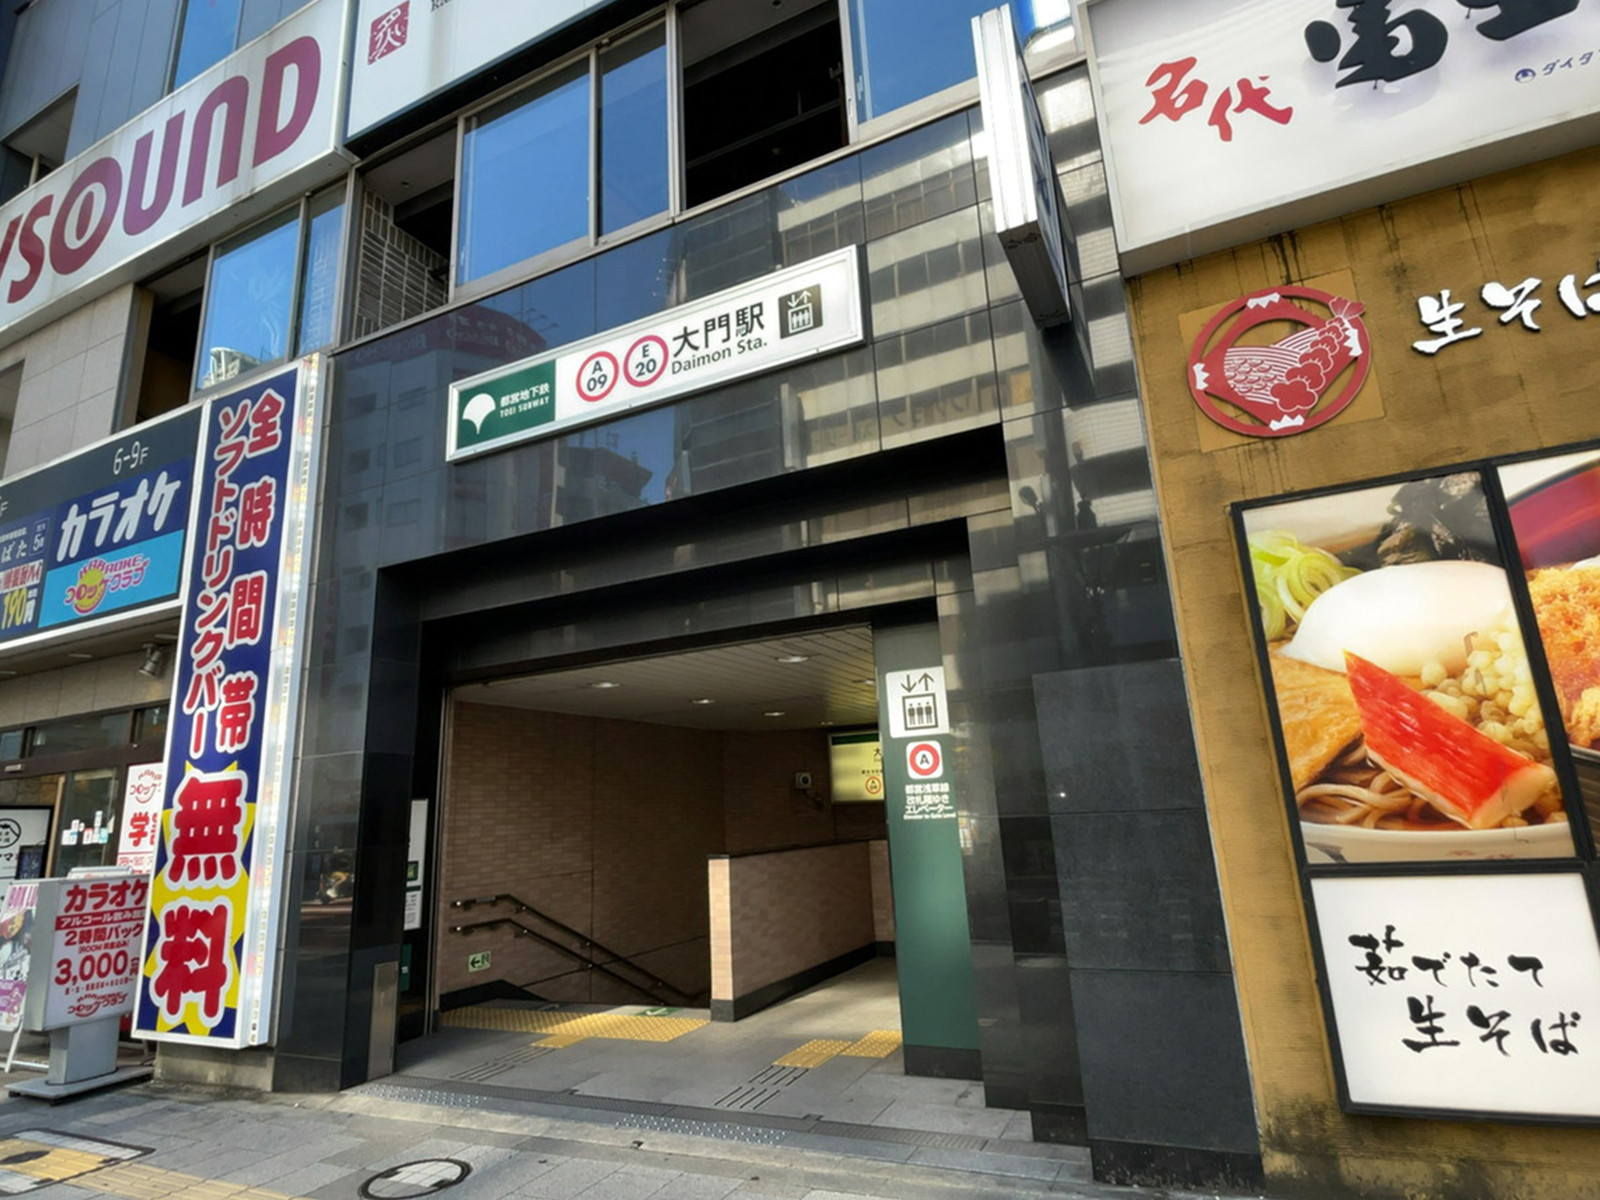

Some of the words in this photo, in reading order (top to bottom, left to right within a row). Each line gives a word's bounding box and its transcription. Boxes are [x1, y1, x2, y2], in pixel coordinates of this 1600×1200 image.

[1542, 49, 1600, 76] ダイタ
[1138, 56, 1293, 142] 名代
[673, 302, 765, 357] 大門駅
[591, 360, 603, 375] A
[635, 358, 657, 377] 20
[641, 343, 650, 359] E
[672, 348, 732, 375] Daimon
[737, 337, 767, 355] Sta.
[501, 383, 549, 407] 都営地下鉄
[586, 374, 608, 392] 09
[500, 406, 517, 418] TOEI
[518, 396, 549, 413] SUBWAY
[113, 441, 149, 475] 6-9F
[56, 471, 182, 562] カラオケ
[185, 401, 247, 756] ソフトドリンクバー
[219, 391, 284, 750] 全時間帯
[919, 753, 930, 765] A
[905, 804, 954, 814] エレベーター
[64, 879, 148, 913] カラオケ
[154, 776, 243, 1018] 無料
[1348, 925, 1544, 987] 茹でたて
[1402, 995, 1581, 1056] 生そば
